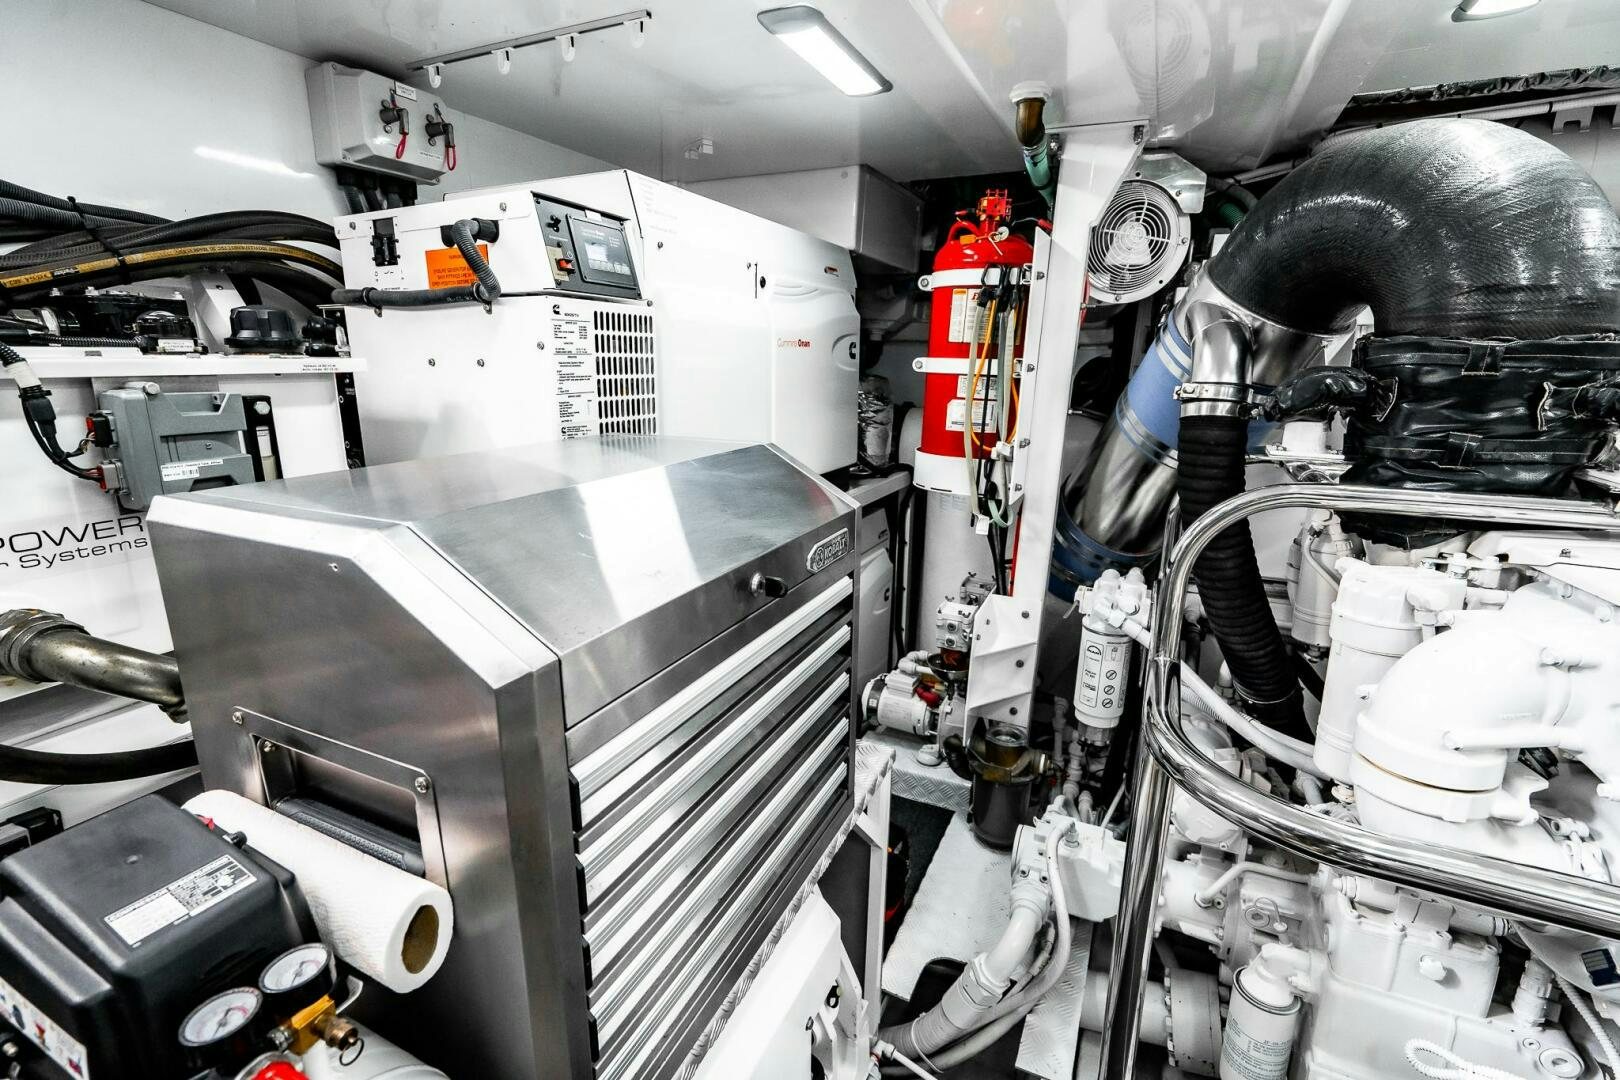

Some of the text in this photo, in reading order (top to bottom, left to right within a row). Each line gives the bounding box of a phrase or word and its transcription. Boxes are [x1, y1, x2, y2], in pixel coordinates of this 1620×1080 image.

[797, 338, 811, 348] Onan
[0, 515, 144, 553] OWER
[19, 537, 149, 569] Systems
